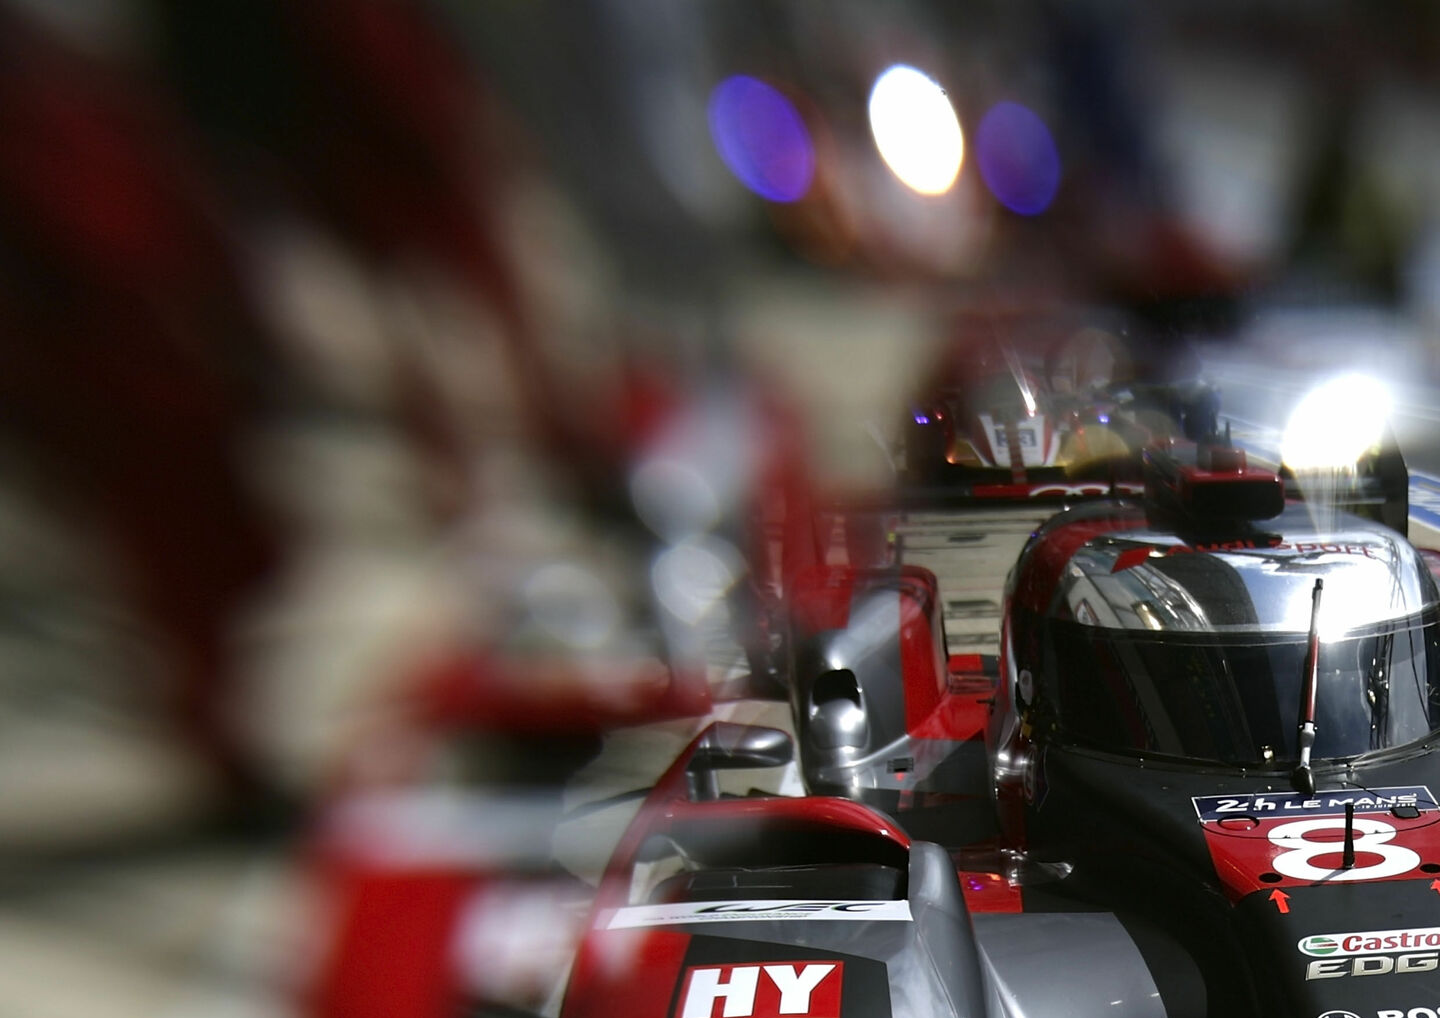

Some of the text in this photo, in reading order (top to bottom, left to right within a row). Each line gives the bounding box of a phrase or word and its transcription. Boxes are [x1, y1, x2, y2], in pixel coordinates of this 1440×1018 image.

[1284, 798, 1321, 809] LE
[1328, 793, 1417, 809] MANS
[1267, 818, 1422, 881] 8
